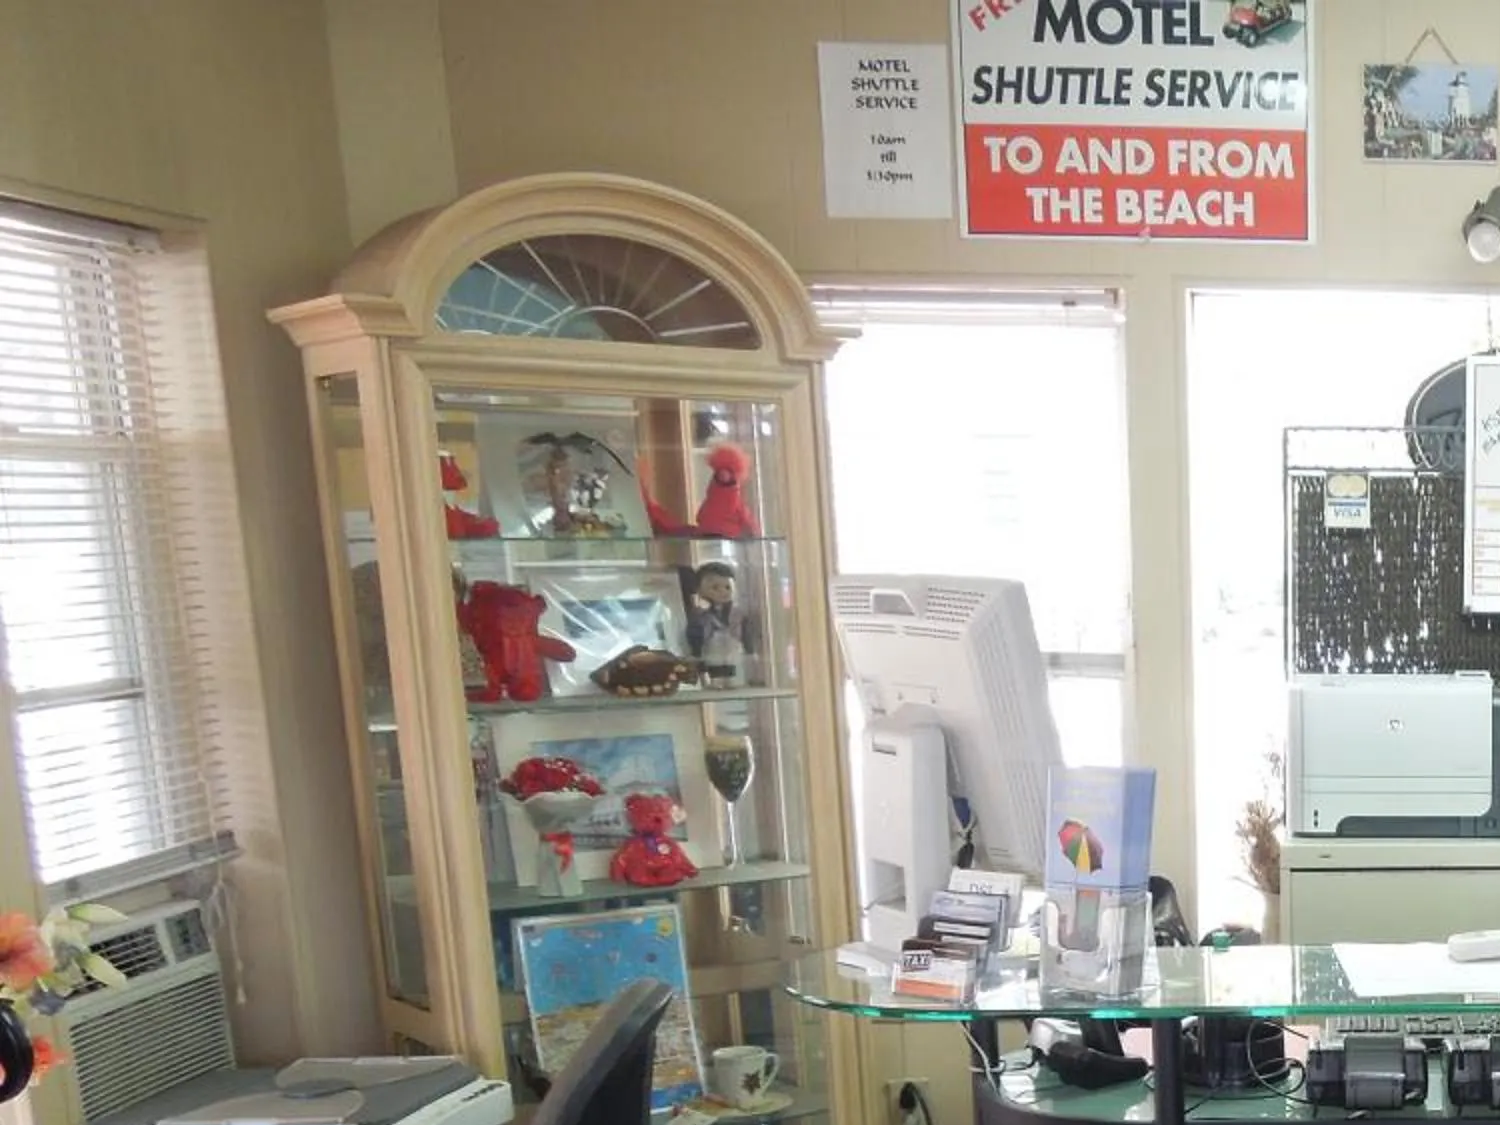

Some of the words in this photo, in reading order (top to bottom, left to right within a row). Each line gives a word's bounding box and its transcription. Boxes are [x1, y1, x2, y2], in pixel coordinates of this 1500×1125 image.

[1033, 0, 1214, 46] MOTEL
[851, 77, 920, 91] SHUTTLE
[859, 59, 911, 73] MOTEL
[855, 96, 919, 109] SERVICE
[972, 65, 1133, 106] SHUTTLE
[1145, 69, 1299, 111] SERVICE
[983, 136, 1043, 176] TO
[1055, 138, 1155, 176] AND
[1168, 139, 1295, 179] FROM
[1025, 187, 1103, 224] THE
[1116, 189, 1256, 228] BEACH
